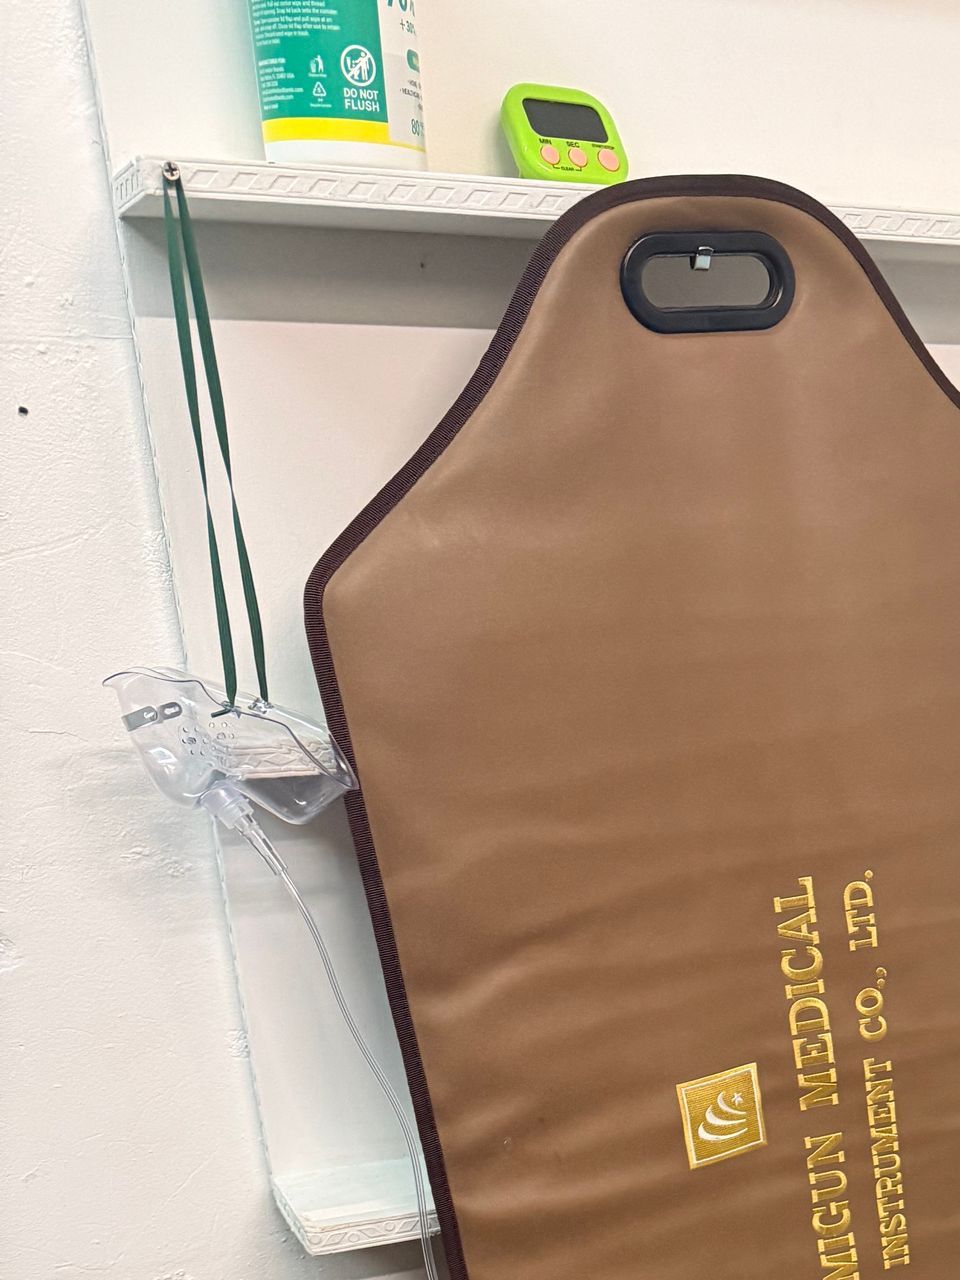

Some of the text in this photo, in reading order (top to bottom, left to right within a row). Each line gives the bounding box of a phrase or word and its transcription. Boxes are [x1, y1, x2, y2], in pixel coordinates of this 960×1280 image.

[344, 88, 378, 100] DO NOT
[345, 99, 380, 112] FLUSH
[773, 875, 839, 1111] MEDICAL
[843, 869, 910, 1270] INSTRUMENT CO., LTD.
